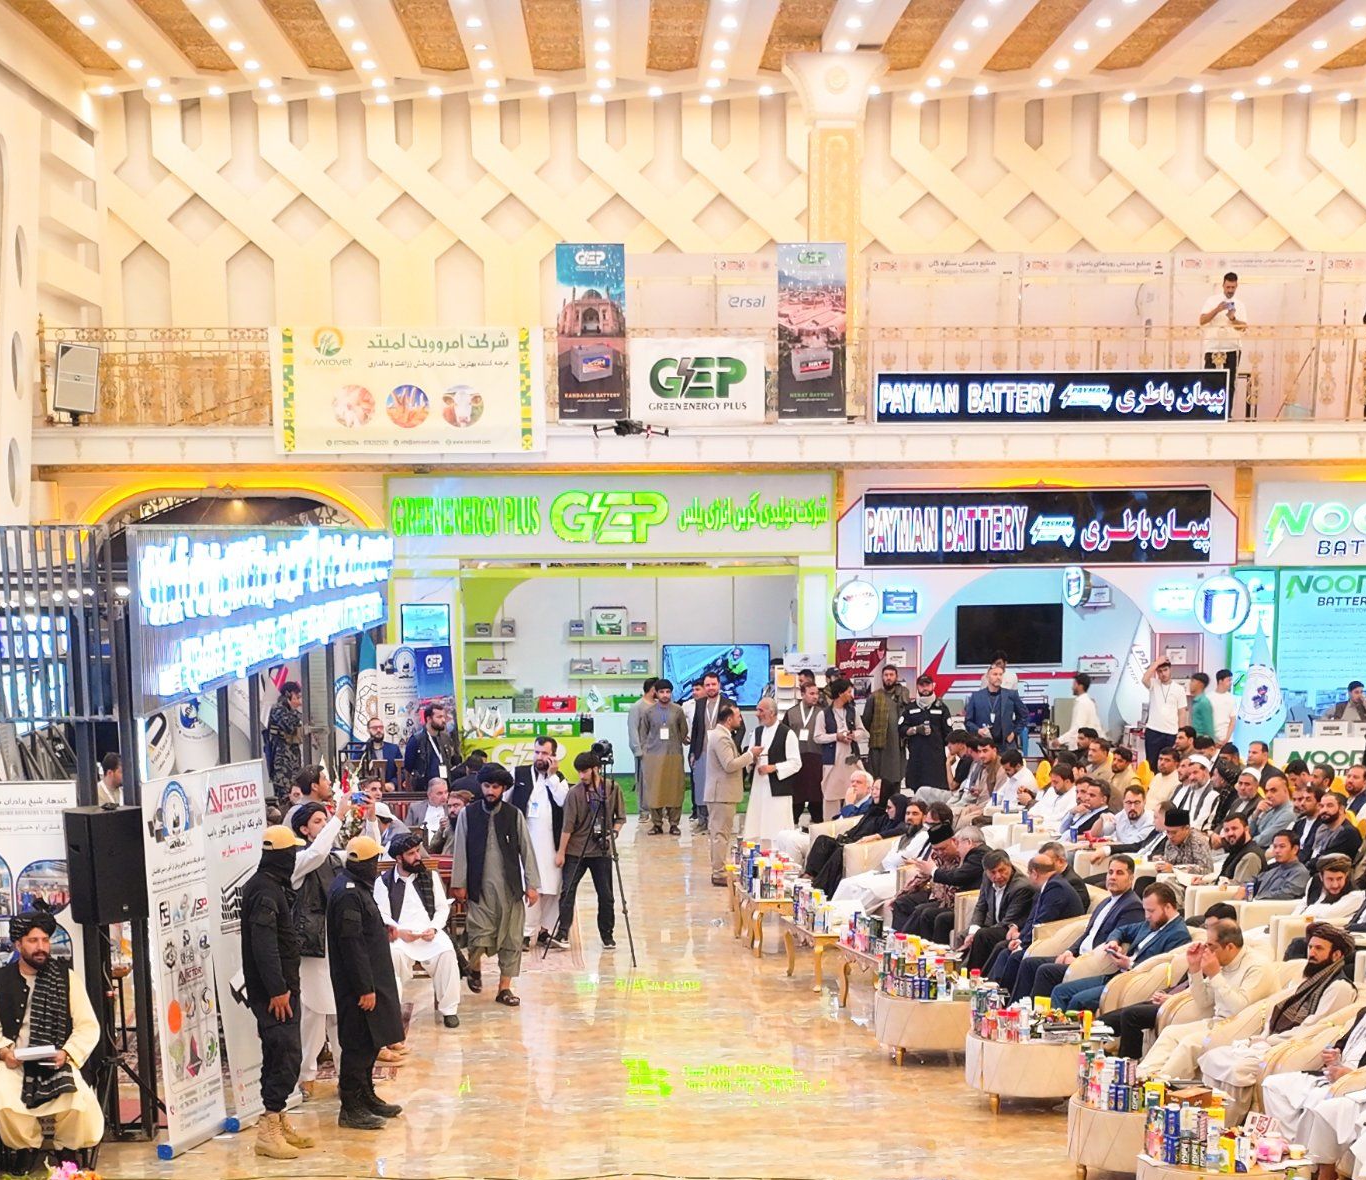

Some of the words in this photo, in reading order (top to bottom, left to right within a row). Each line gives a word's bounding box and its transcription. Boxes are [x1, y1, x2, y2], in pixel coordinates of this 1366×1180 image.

[649, 357, 747, 399] GEP
[723, 402, 747, 410] PLUS
[878, 382, 960, 415] PAYMAN
[967, 382, 1056, 415] BATTERY
[1115, 381, 1174, 415] باطری
[1175, 382, 1227, 414] پیمان
[550, 491, 670, 545] GEP
[864, 506, 939, 553] PAYMAN
[942, 505, 1029, 552] BATTERY
